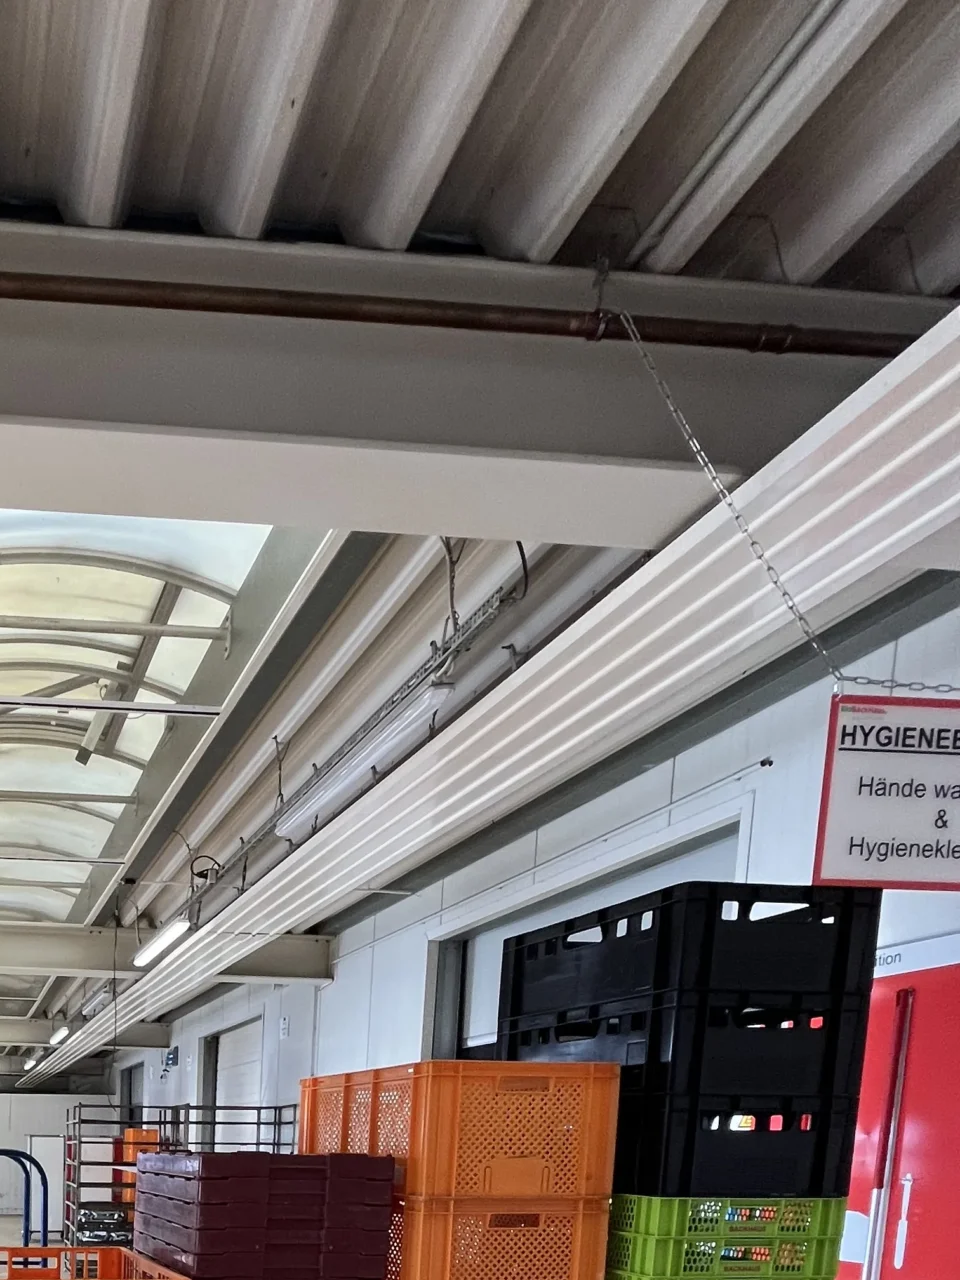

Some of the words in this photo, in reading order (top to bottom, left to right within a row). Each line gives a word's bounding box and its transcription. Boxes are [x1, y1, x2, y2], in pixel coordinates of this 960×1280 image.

[858, 776, 927, 799] Hände
[934, 809, 949, 829] &
[848, 836, 960, 862] Hygienekle
